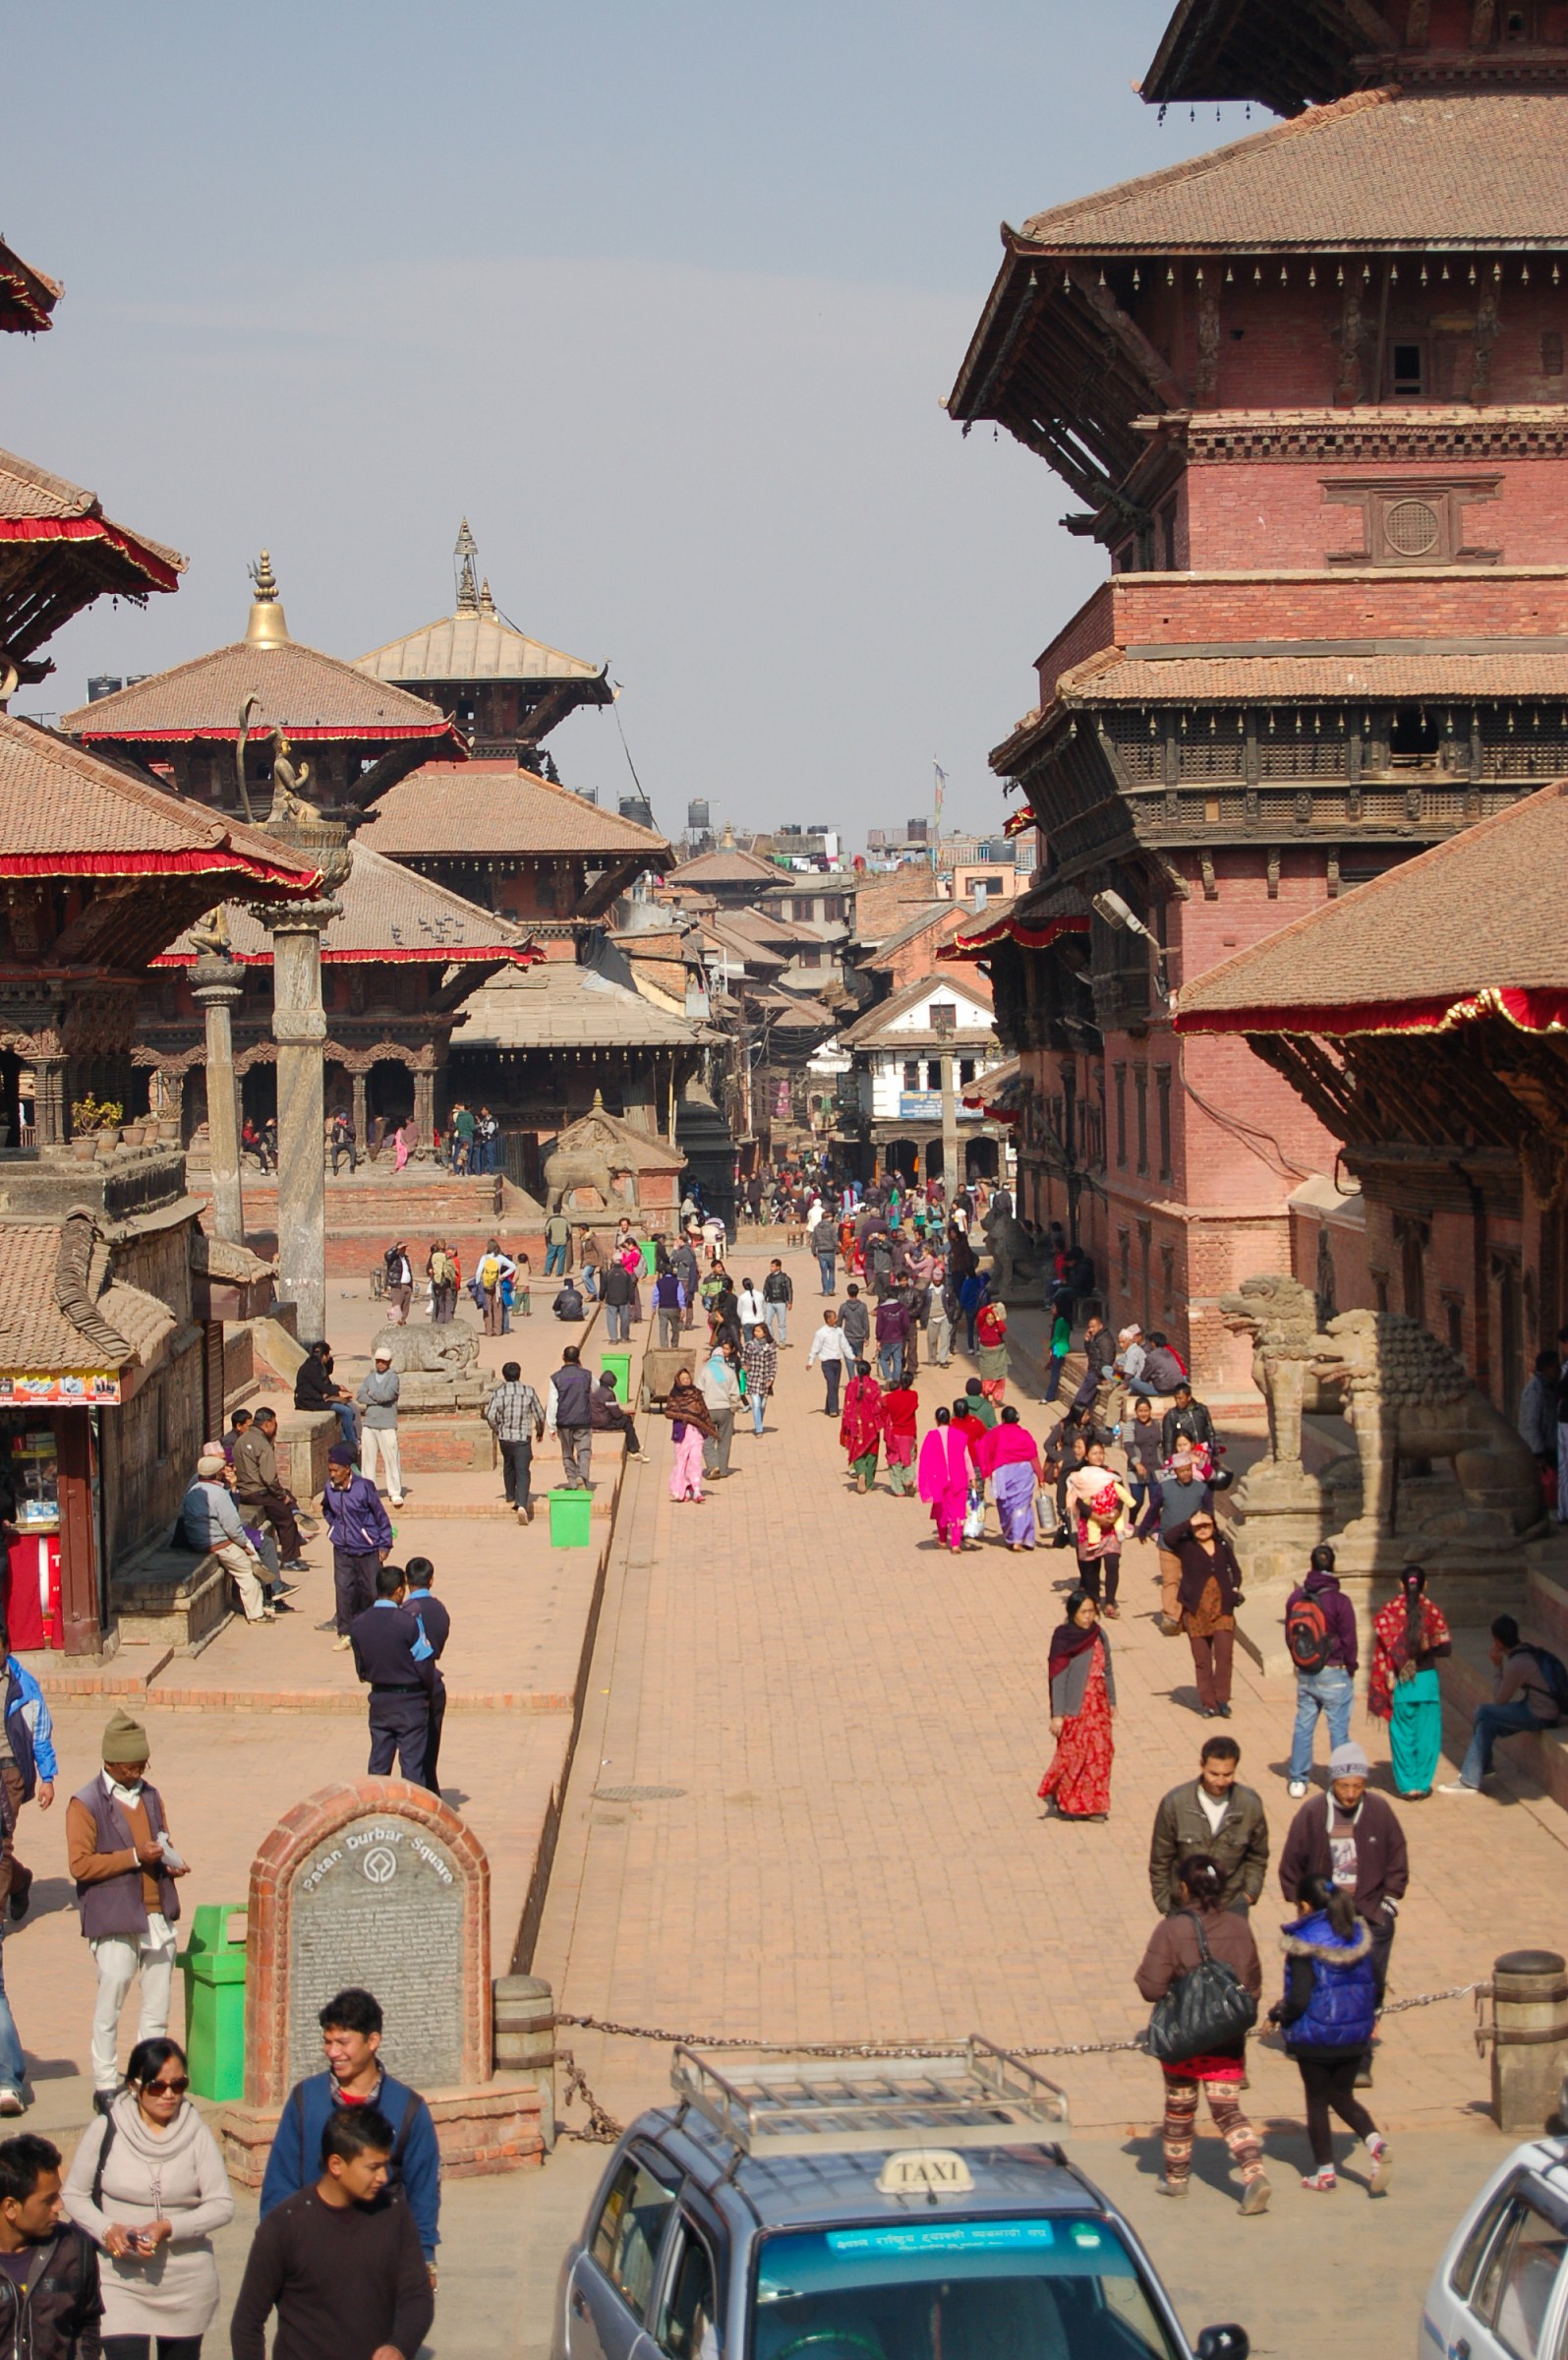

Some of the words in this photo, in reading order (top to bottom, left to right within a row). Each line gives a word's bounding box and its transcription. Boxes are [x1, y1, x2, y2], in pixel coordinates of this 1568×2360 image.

[303, 1849, 343, 1892] Patan
[346, 1827, 404, 1850] Durbar
[410, 1837, 454, 1885] Square
[897, 2161, 958, 2182] TAXI
